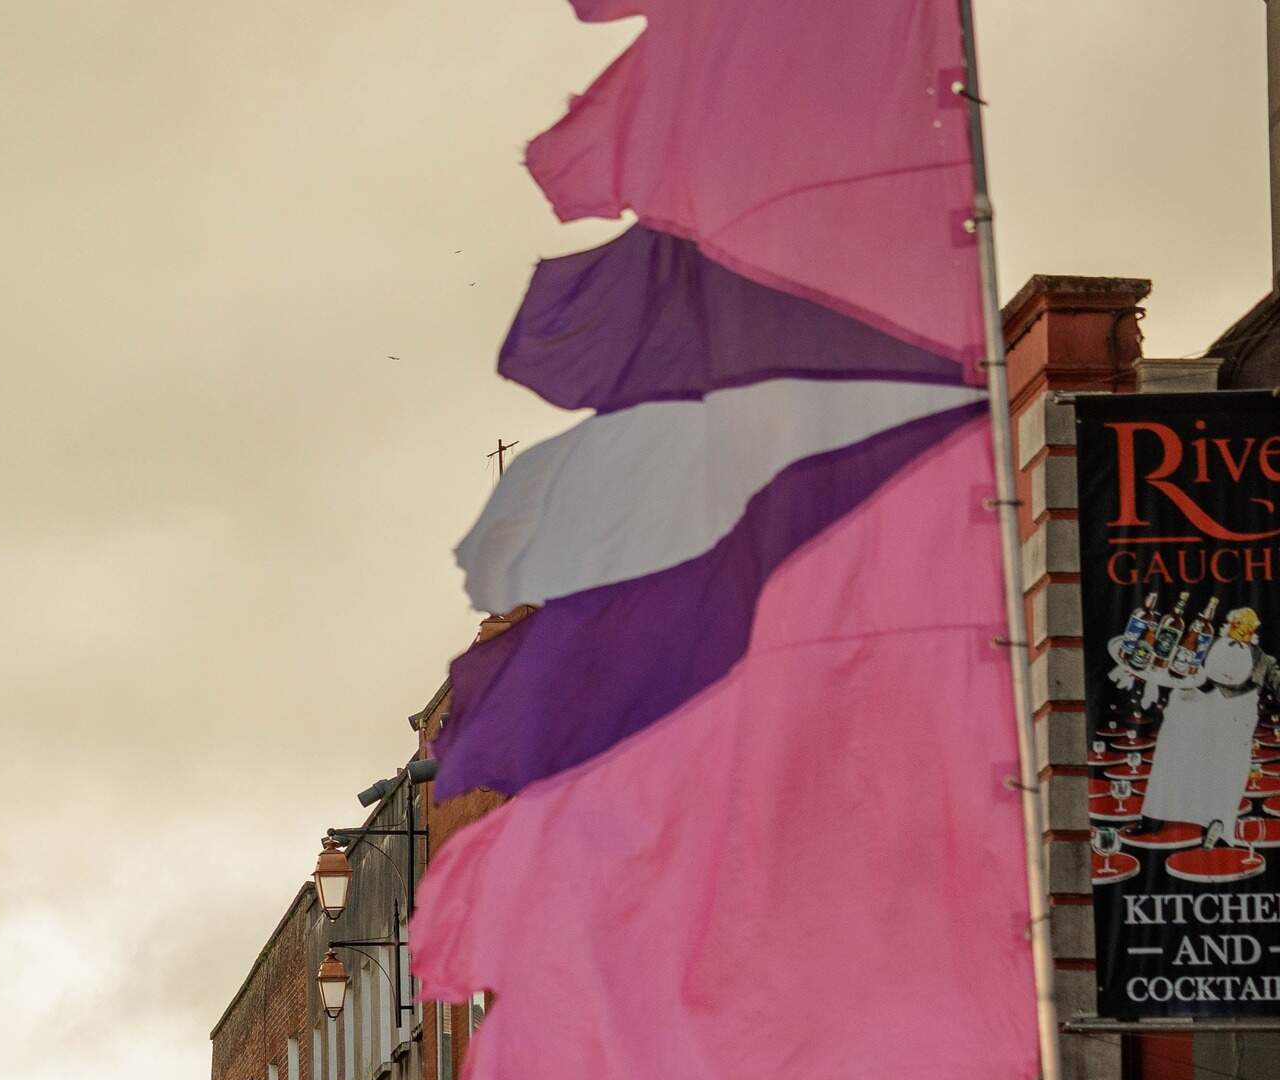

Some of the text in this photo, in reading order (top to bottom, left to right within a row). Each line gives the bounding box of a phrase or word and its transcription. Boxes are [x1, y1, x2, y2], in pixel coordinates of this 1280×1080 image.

[1106, 548, 1280, 585] GAUCH
[1122, 893, 1280, 924] KITCHE
[1172, 935, 1261, 966] AND
[1126, 975, 1280, 1002] COCKTAI
